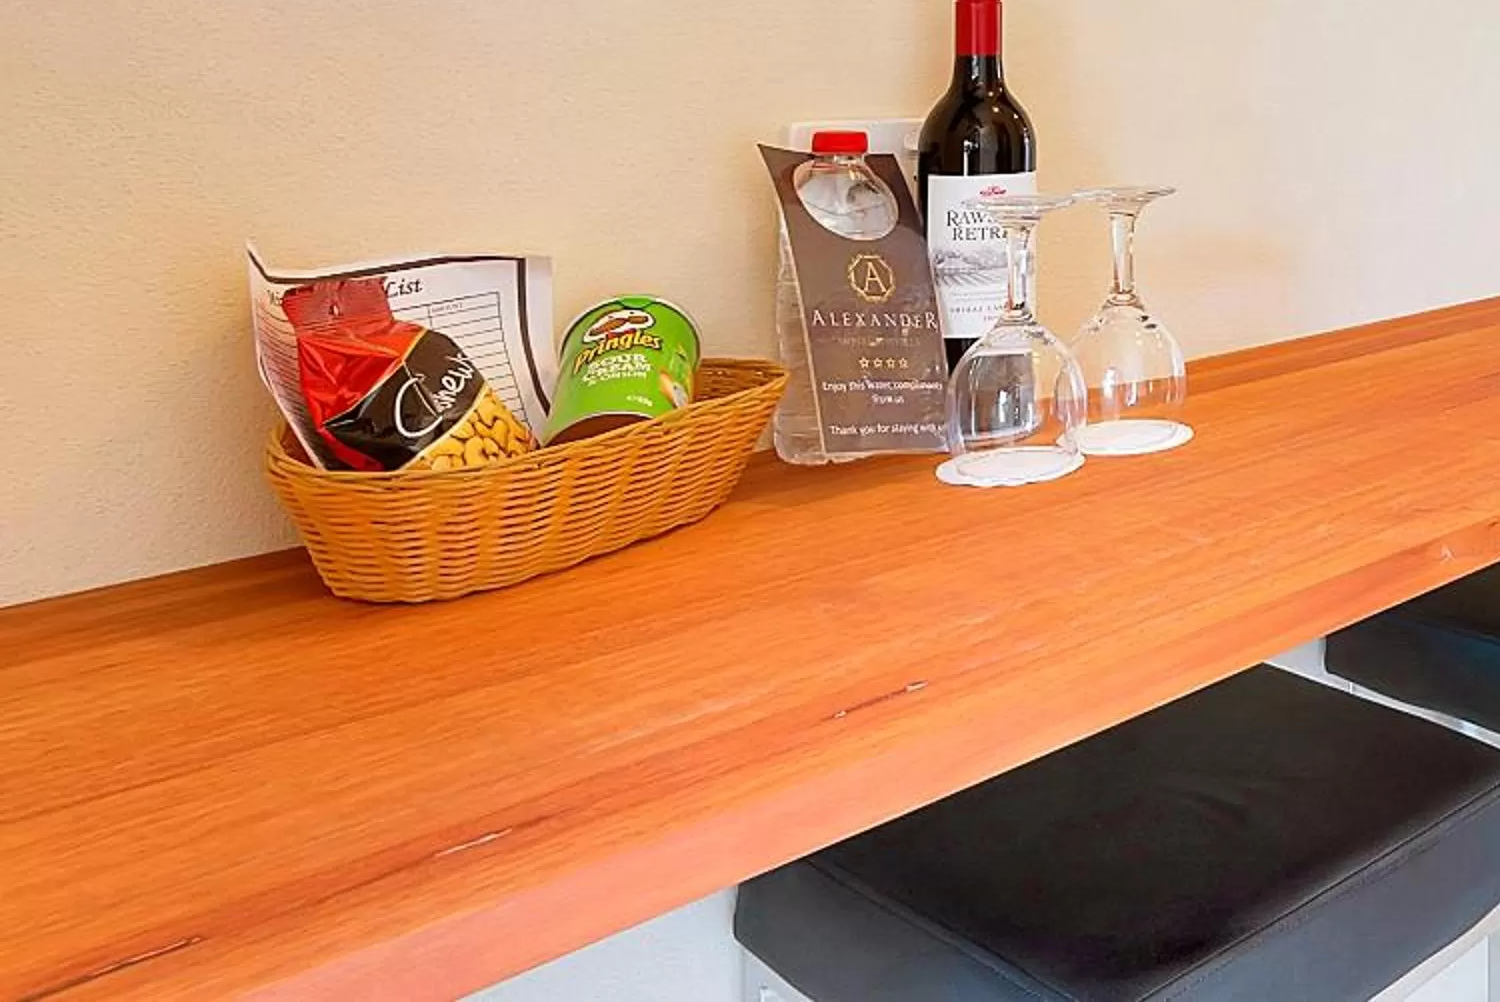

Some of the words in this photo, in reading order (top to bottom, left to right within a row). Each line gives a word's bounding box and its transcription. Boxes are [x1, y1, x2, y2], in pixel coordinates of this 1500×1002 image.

[385, 277, 423, 297] List
[864, 261, 887, 293] A
[811, 309, 939, 331] ALEXANDER
[573, 330, 664, 374] Pringles
[822, 381, 847, 393] Enjoy
[829, 424, 858, 435] Thank
[860, 425, 877, 437] you
[877, 423, 891, 434] for
[892, 422, 920, 435] staying
